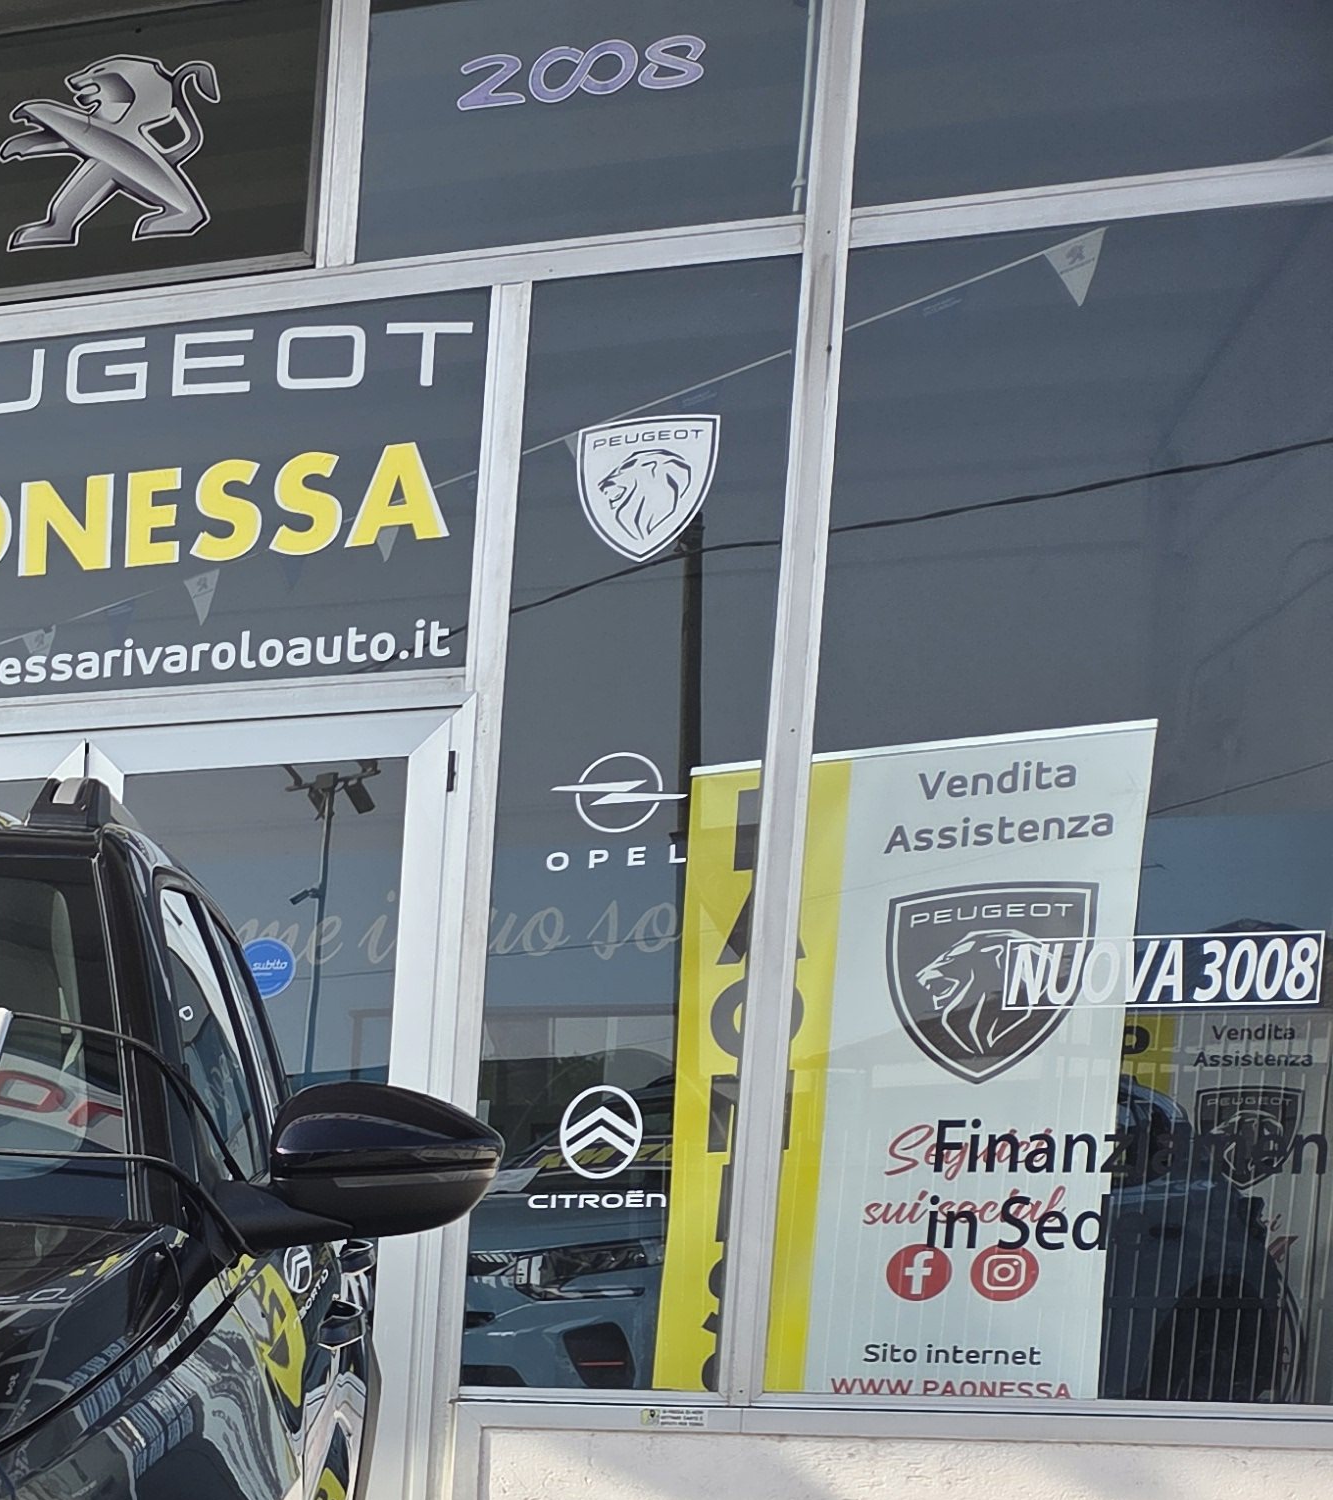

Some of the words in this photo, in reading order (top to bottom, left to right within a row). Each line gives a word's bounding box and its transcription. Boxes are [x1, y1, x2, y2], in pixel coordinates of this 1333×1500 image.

[456, 34, 707, 111] 2008
[593, 429, 704, 450] PEUGEOT
[918, 760, 1077, 800] Vendita
[883, 812, 1114, 854] Assistenza
[546, 844, 687, 872] OPEL
[910, 903, 1074, 928] PEUGEOT
[1007, 939, 1183, 1005] NUOVA
[1193, 937, 1320, 1002] 3008
[1212, 1024, 1295, 1042] Vendita
[1194, 1051, 1313, 1067] Assistenza
[528, 1190, 668, 1209] CITROËN
[926, 1195, 978, 1249] in
[863, 1343, 917, 1364] Sito
[926, 1343, 1042, 1366] internet
